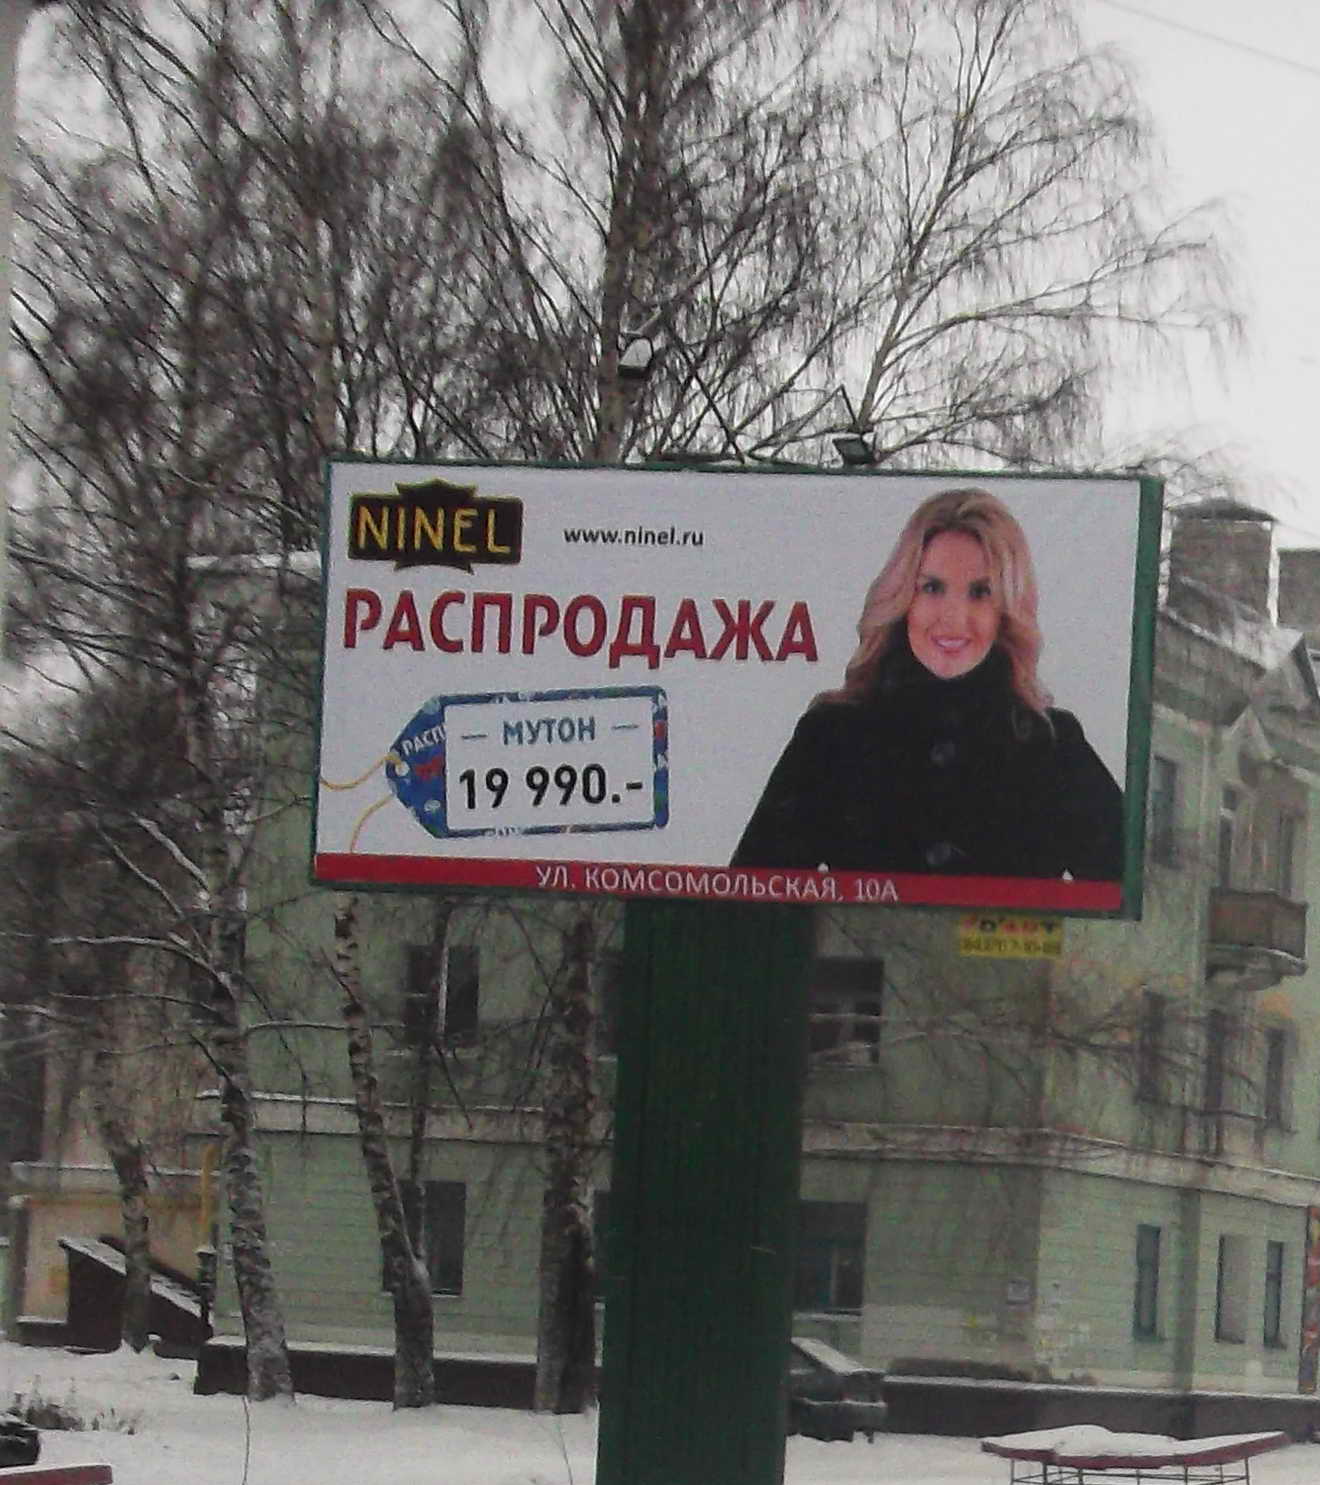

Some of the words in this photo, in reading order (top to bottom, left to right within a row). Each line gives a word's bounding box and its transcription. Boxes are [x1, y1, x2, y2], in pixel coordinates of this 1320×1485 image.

[357, 505, 511, 554] NINEL
[563, 525, 705, 548] www.ninel.ru
[343, 587, 819, 669] РАСПРОДАЖА
[502, 716, 597, 746] МУТОН
[459, 767, 509, 810] 19
[525, 763, 643, 806] 990.-
[535, 865, 577, 889] УЛ.
[584, 866, 844, 902] КОМСОМОЛЬСКАЯ,
[853, 877, 899, 902] 10А
